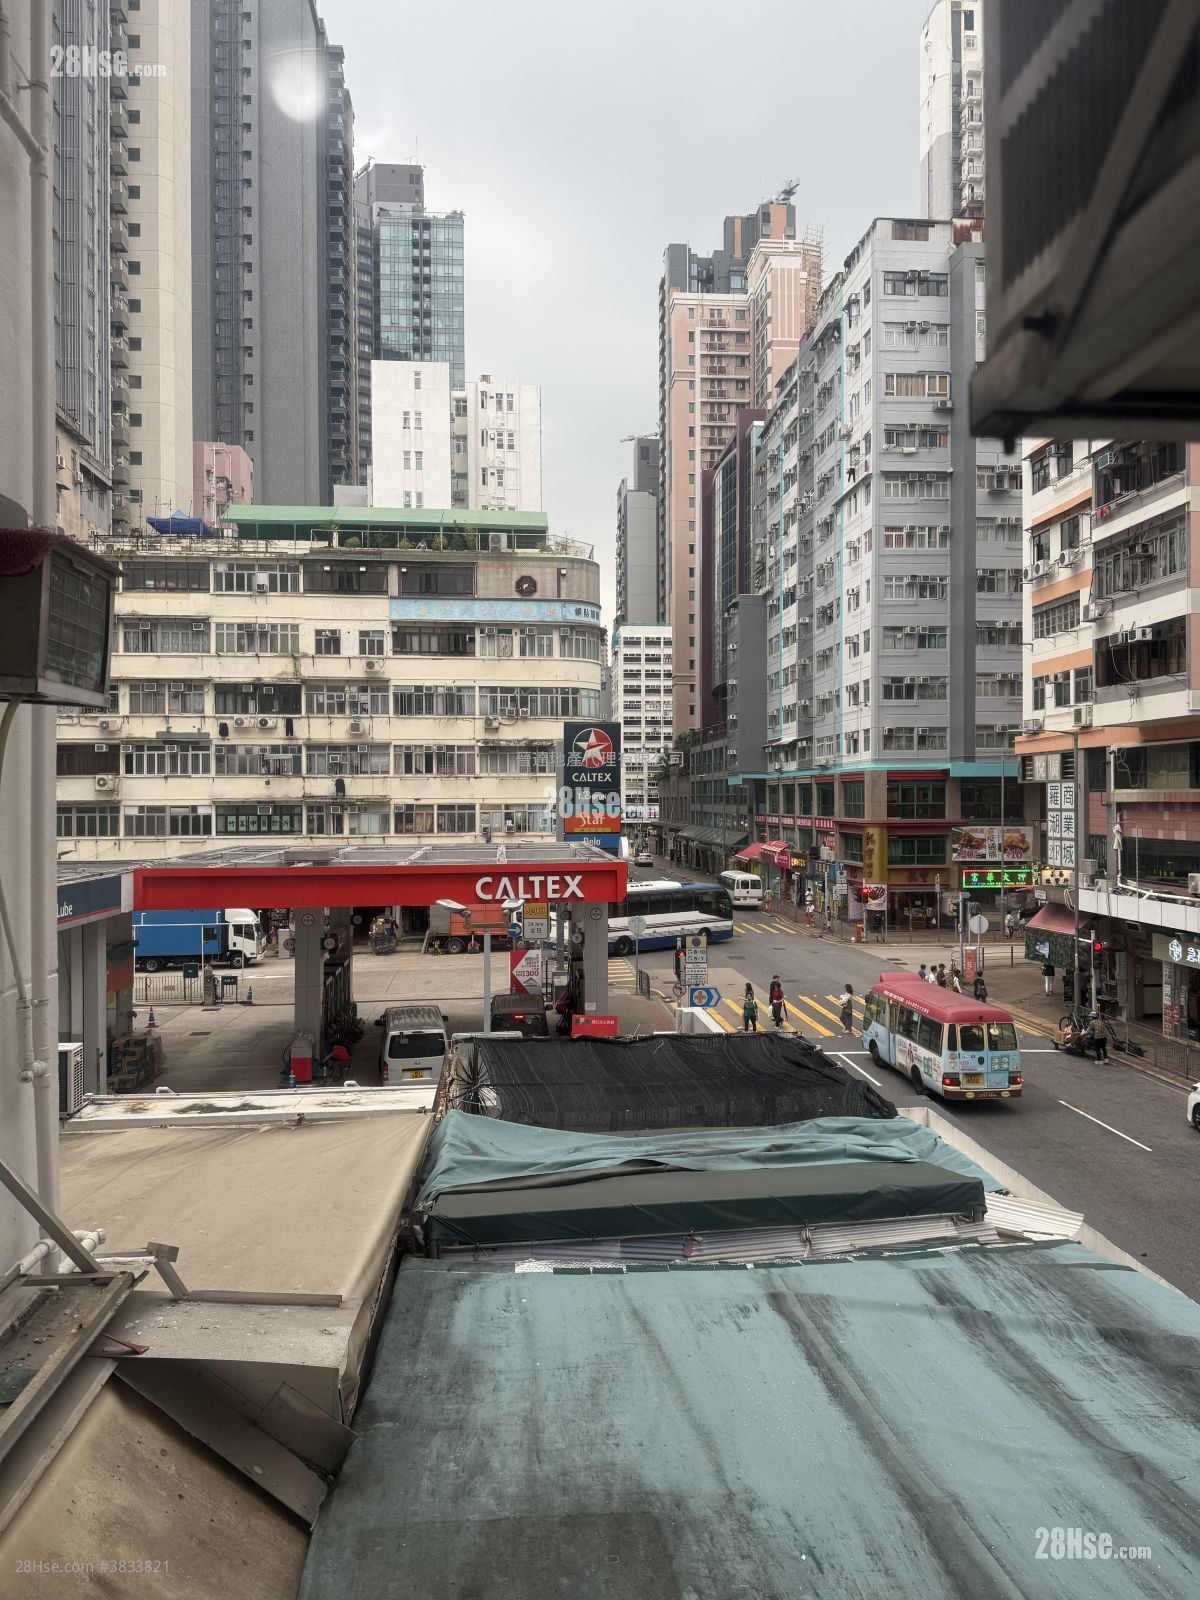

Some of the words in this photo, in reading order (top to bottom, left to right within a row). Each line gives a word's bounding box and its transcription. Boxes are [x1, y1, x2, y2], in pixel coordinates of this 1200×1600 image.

[572, 773, 612, 782] CALTEX
[579, 812, 605, 827] Star
[1063, 783, 1074, 864] 商業城
[475, 875, 585, 900] CALTEX
[56, 901, 73, 917] Lube
